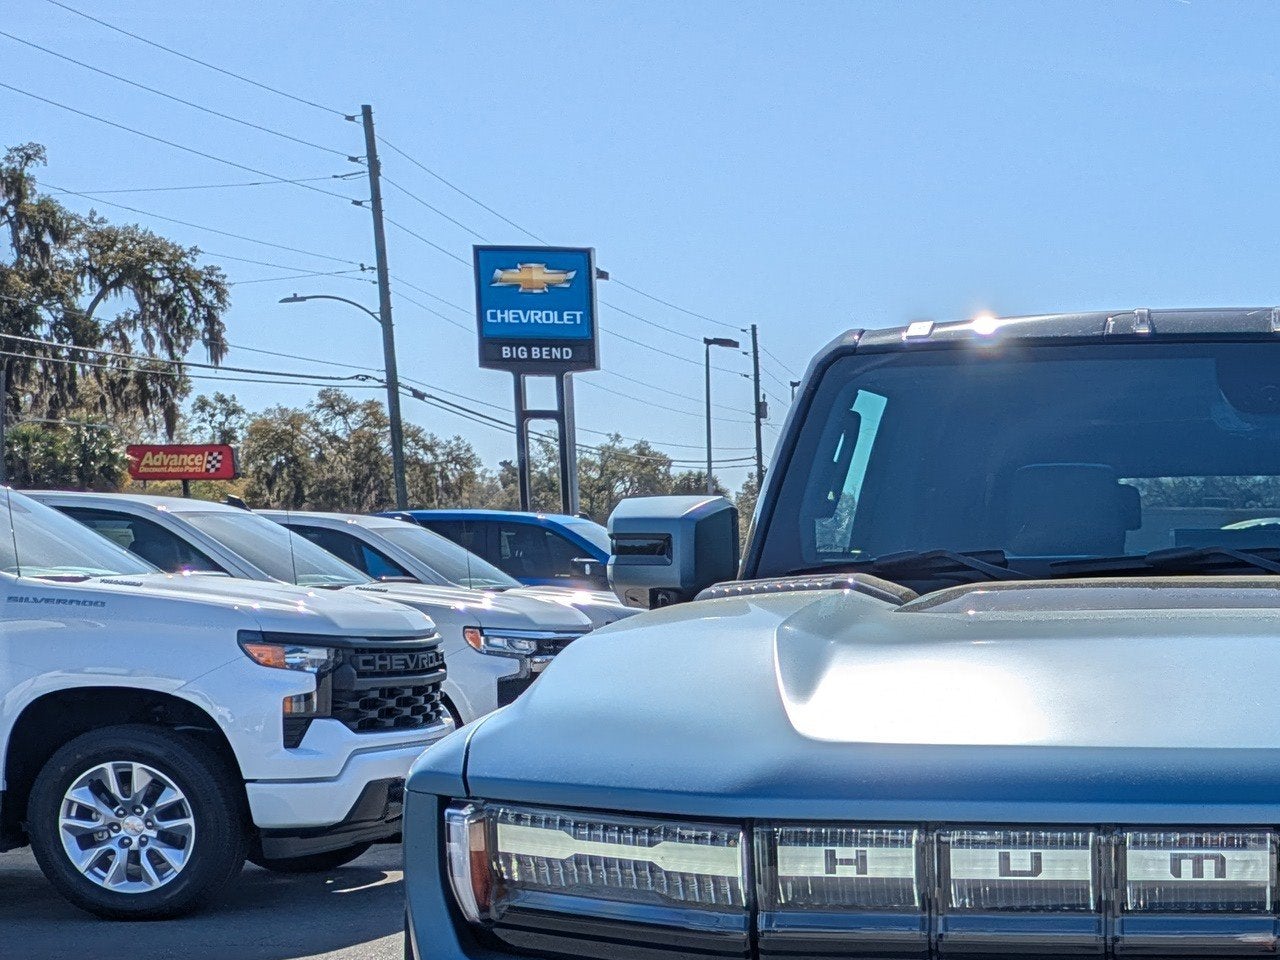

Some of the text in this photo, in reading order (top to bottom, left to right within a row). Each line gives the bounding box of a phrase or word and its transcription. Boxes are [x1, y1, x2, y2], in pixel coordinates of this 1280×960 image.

[486, 309, 583, 325] CHEVROLET
[502, 346, 573, 360] BIG BEND
[140, 451, 203, 466] Advance
[6, 596, 106, 608] SILVERADO
